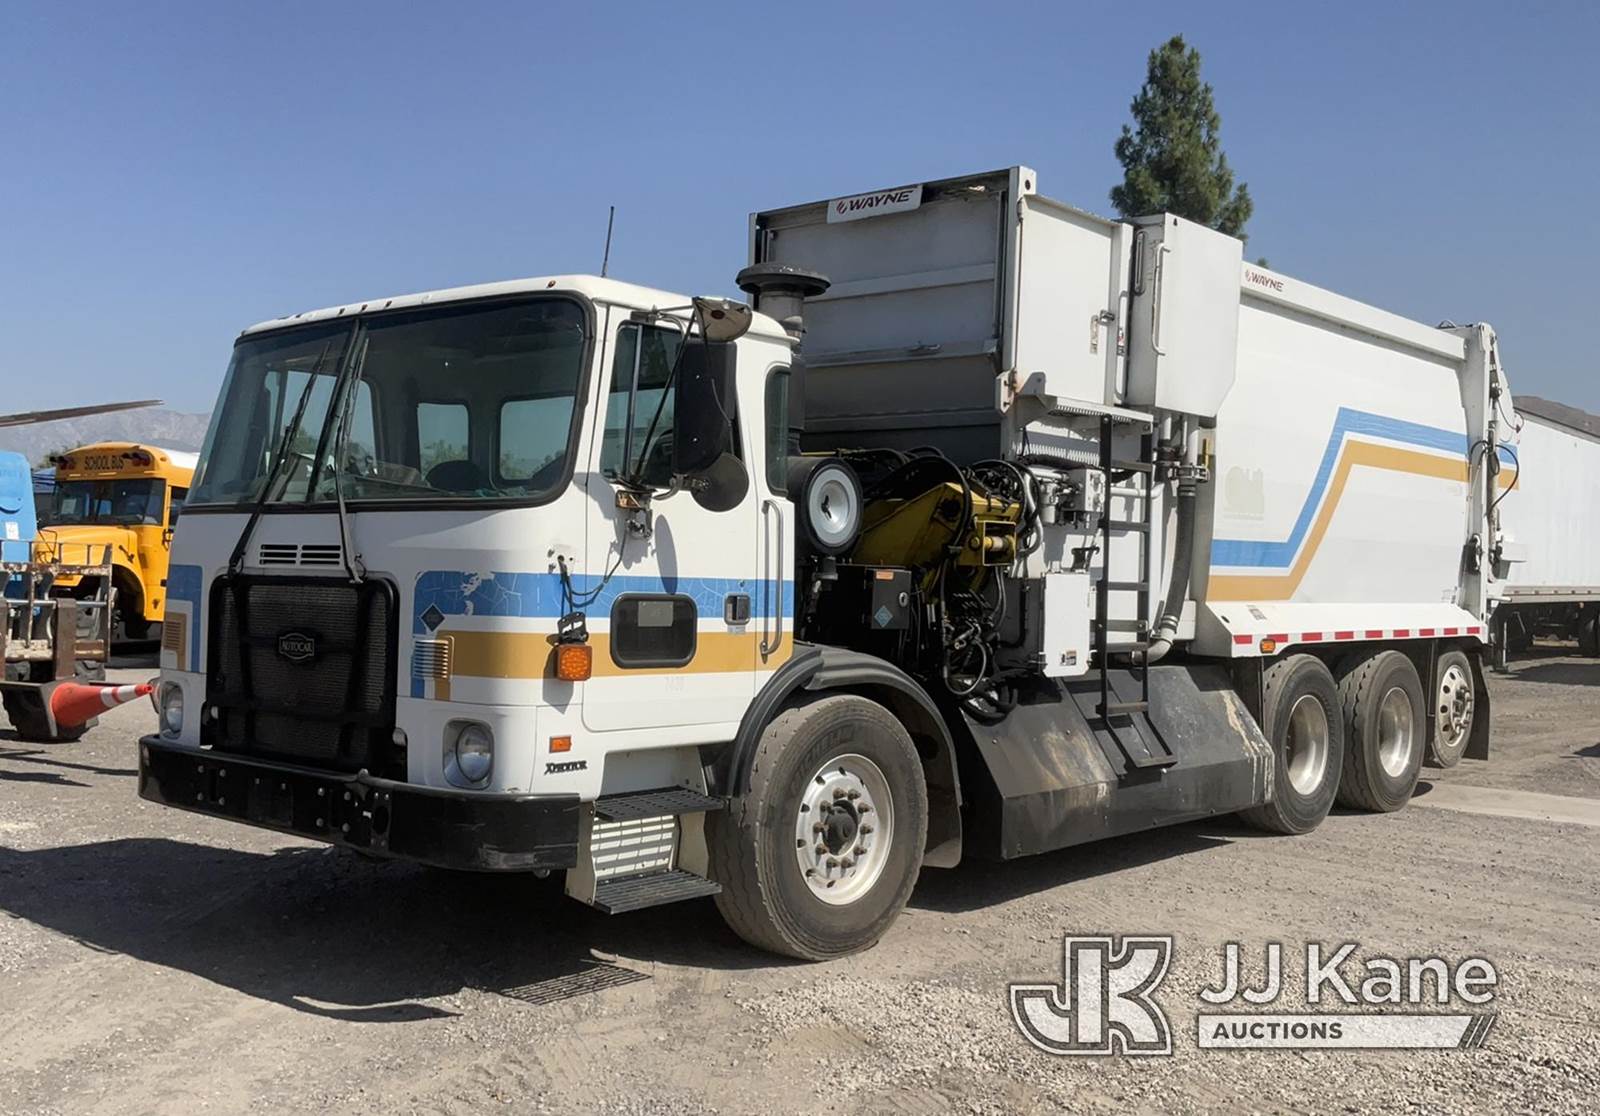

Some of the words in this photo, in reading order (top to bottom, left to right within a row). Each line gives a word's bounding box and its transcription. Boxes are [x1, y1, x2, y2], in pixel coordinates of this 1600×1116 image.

[850, 189, 914, 211] WAYNE
[1251, 271, 1284, 292] WAYNE
[84, 455, 110, 470] SCHOOL
[111, 454, 125, 470] BUS
